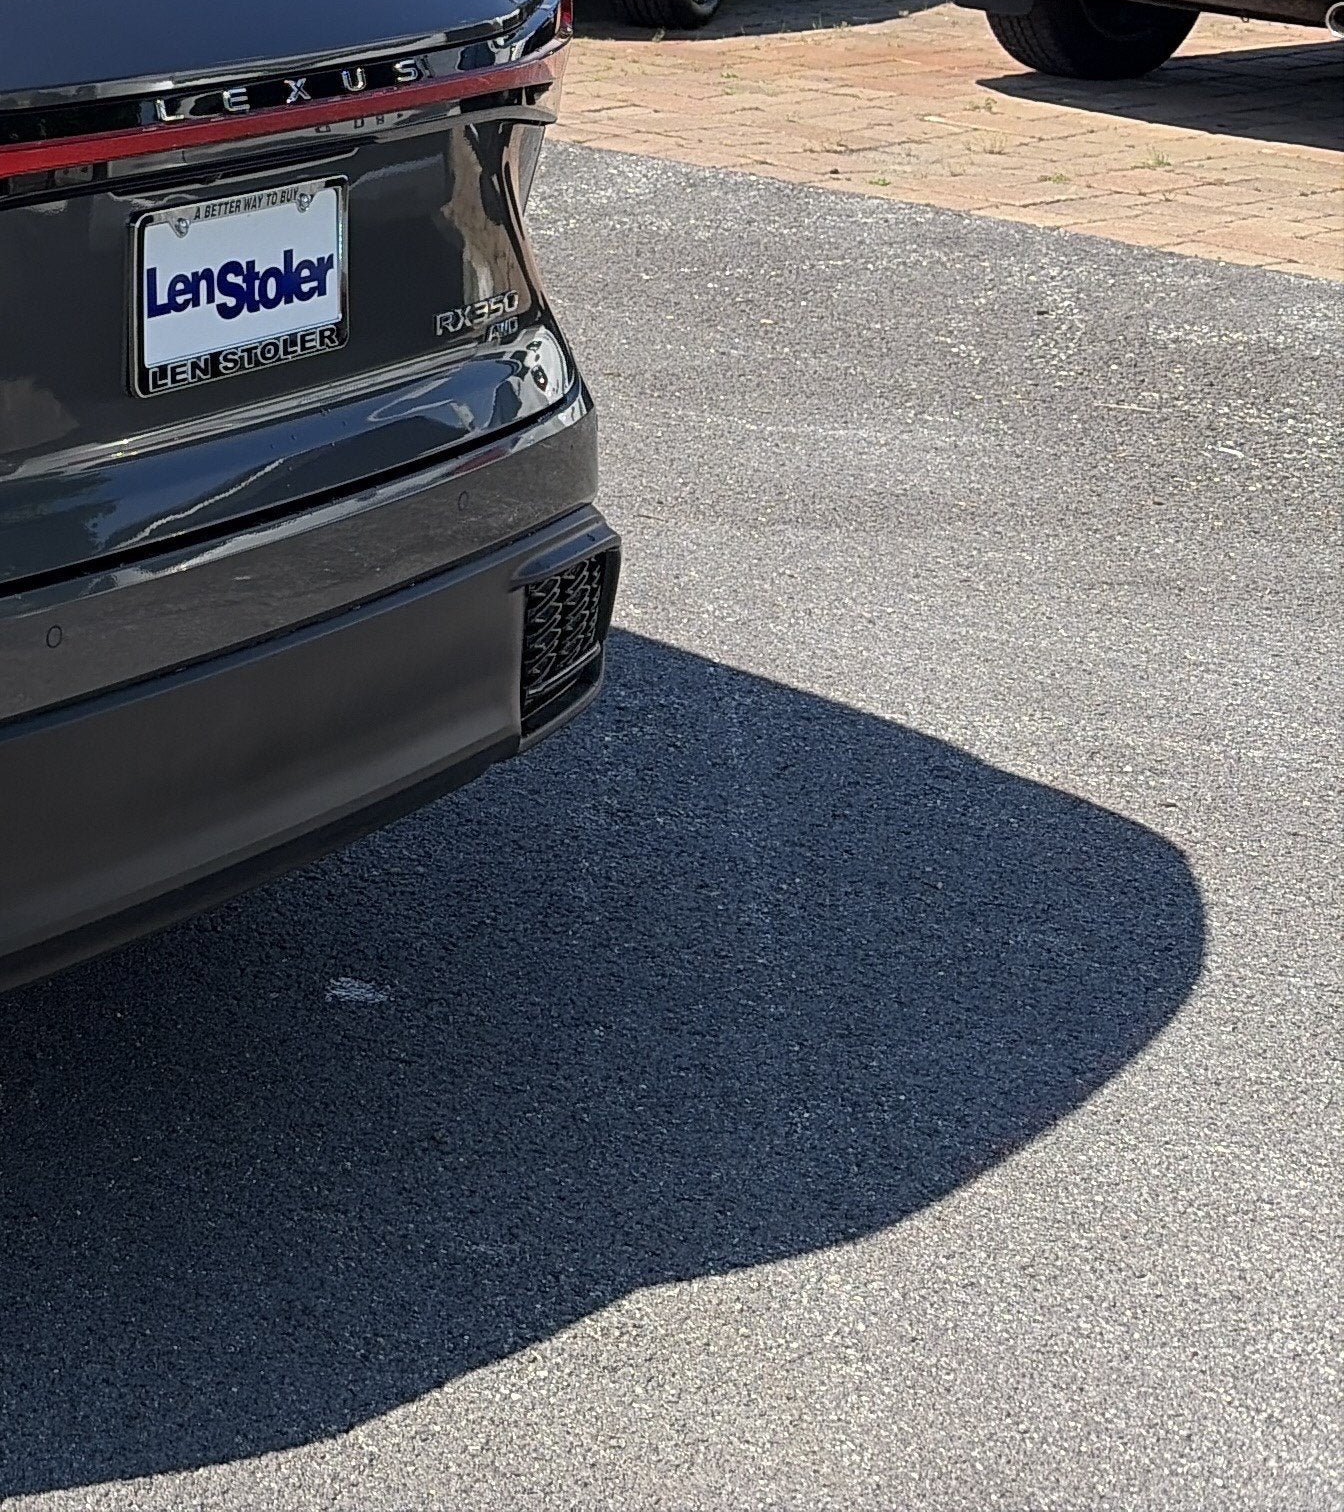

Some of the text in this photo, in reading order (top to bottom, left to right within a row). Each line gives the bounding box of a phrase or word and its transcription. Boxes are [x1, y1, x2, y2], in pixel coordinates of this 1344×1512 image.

[155, 60, 418, 122] LEXUS
[193, 188, 299, 221] A BETTER WAY TO BUY
[149, 325, 339, 392] LEN STOLER
